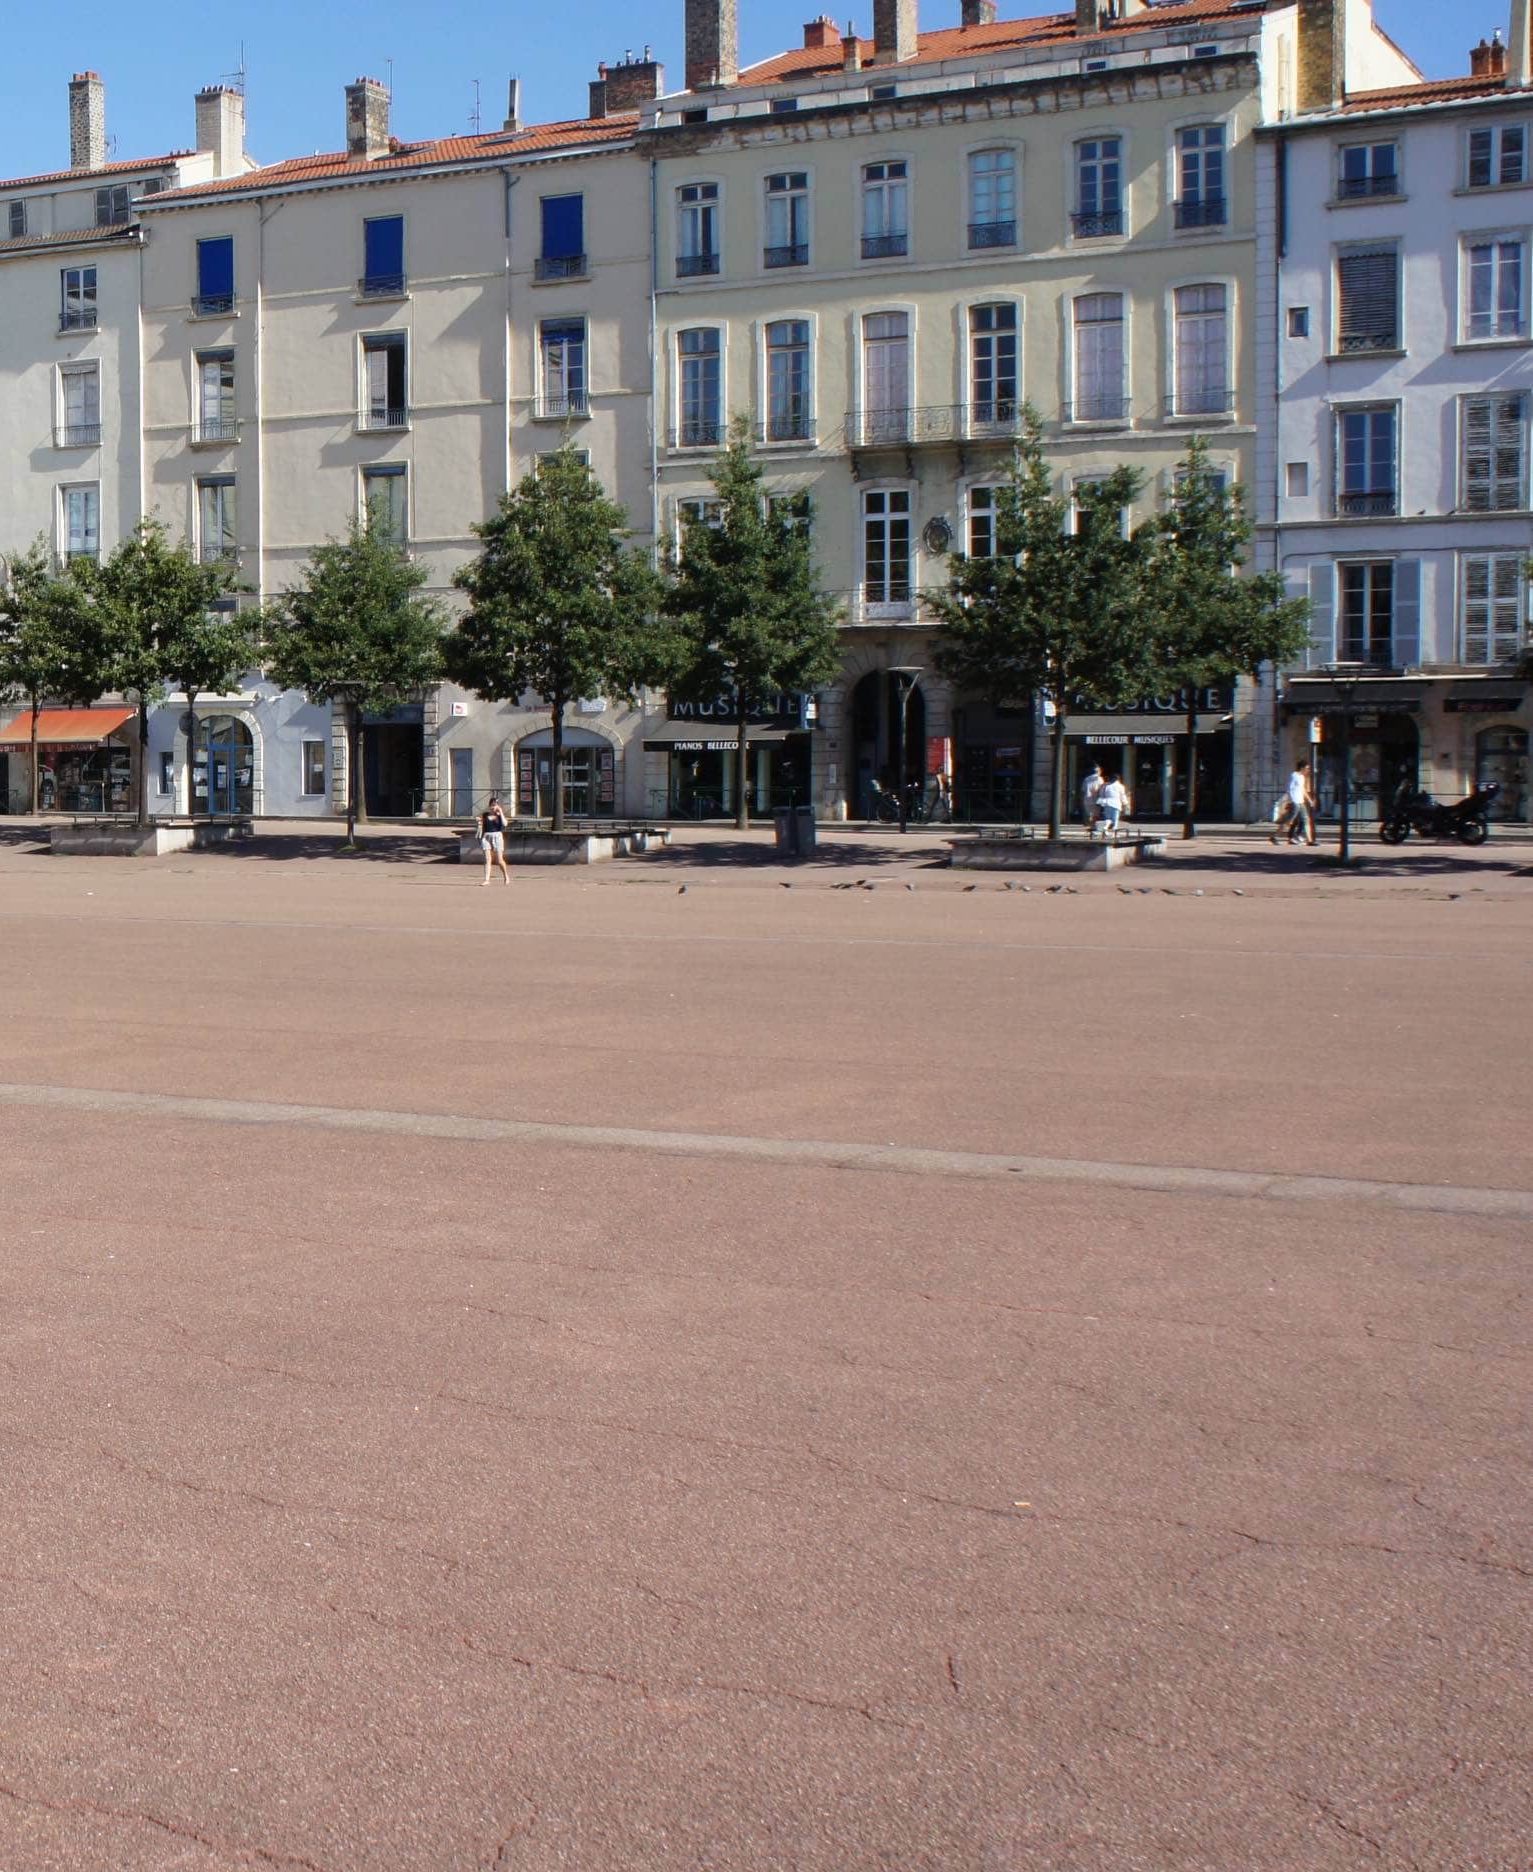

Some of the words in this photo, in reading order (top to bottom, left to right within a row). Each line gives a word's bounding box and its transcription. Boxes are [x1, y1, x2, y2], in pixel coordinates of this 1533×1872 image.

[1086, 736, 1128, 745] BELLECOUR
[1134, 736, 1175, 745] MUSIQUES
[674, 742, 703, 751] PIANOS
[707, 741, 750, 750] BELLECOR
